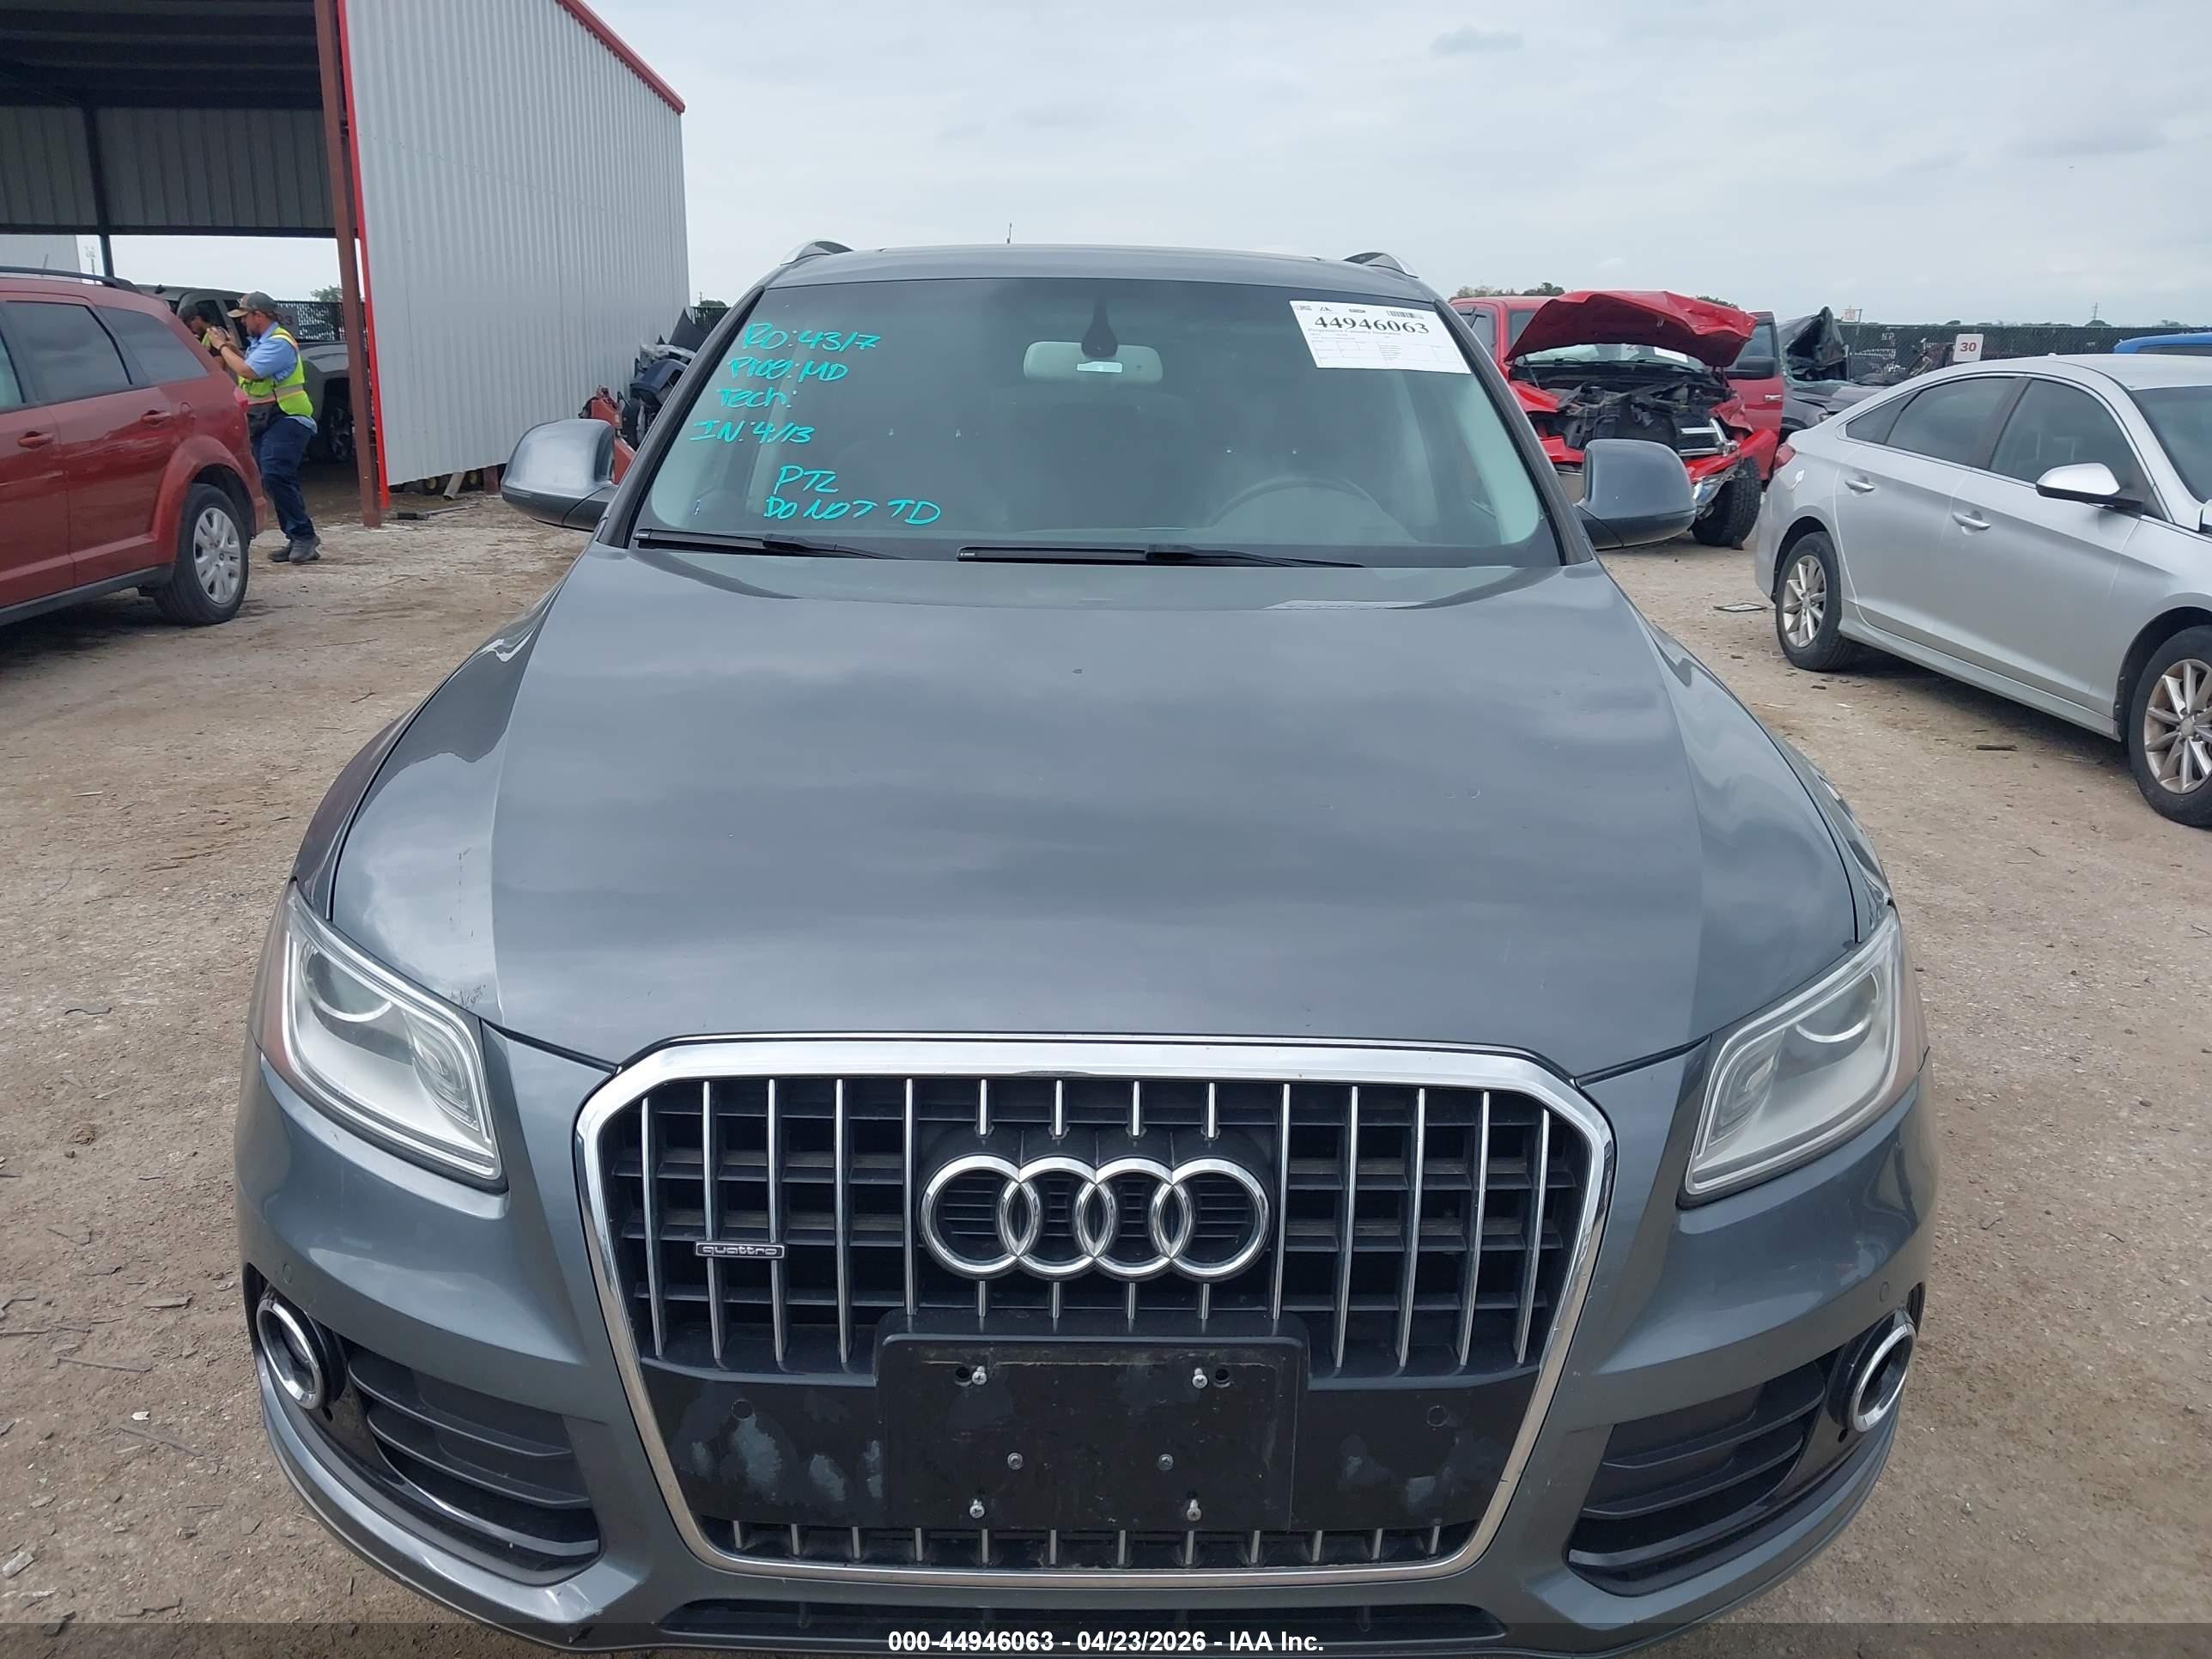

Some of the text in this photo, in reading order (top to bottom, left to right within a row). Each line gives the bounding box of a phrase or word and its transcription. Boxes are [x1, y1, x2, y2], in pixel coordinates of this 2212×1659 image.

[1314, 315, 1430, 335] 44946063
[1960, 342, 1977, 352] 30
[763, 495, 941, 525] DO NOT TD
[702, 1246, 777, 1256] quattro
